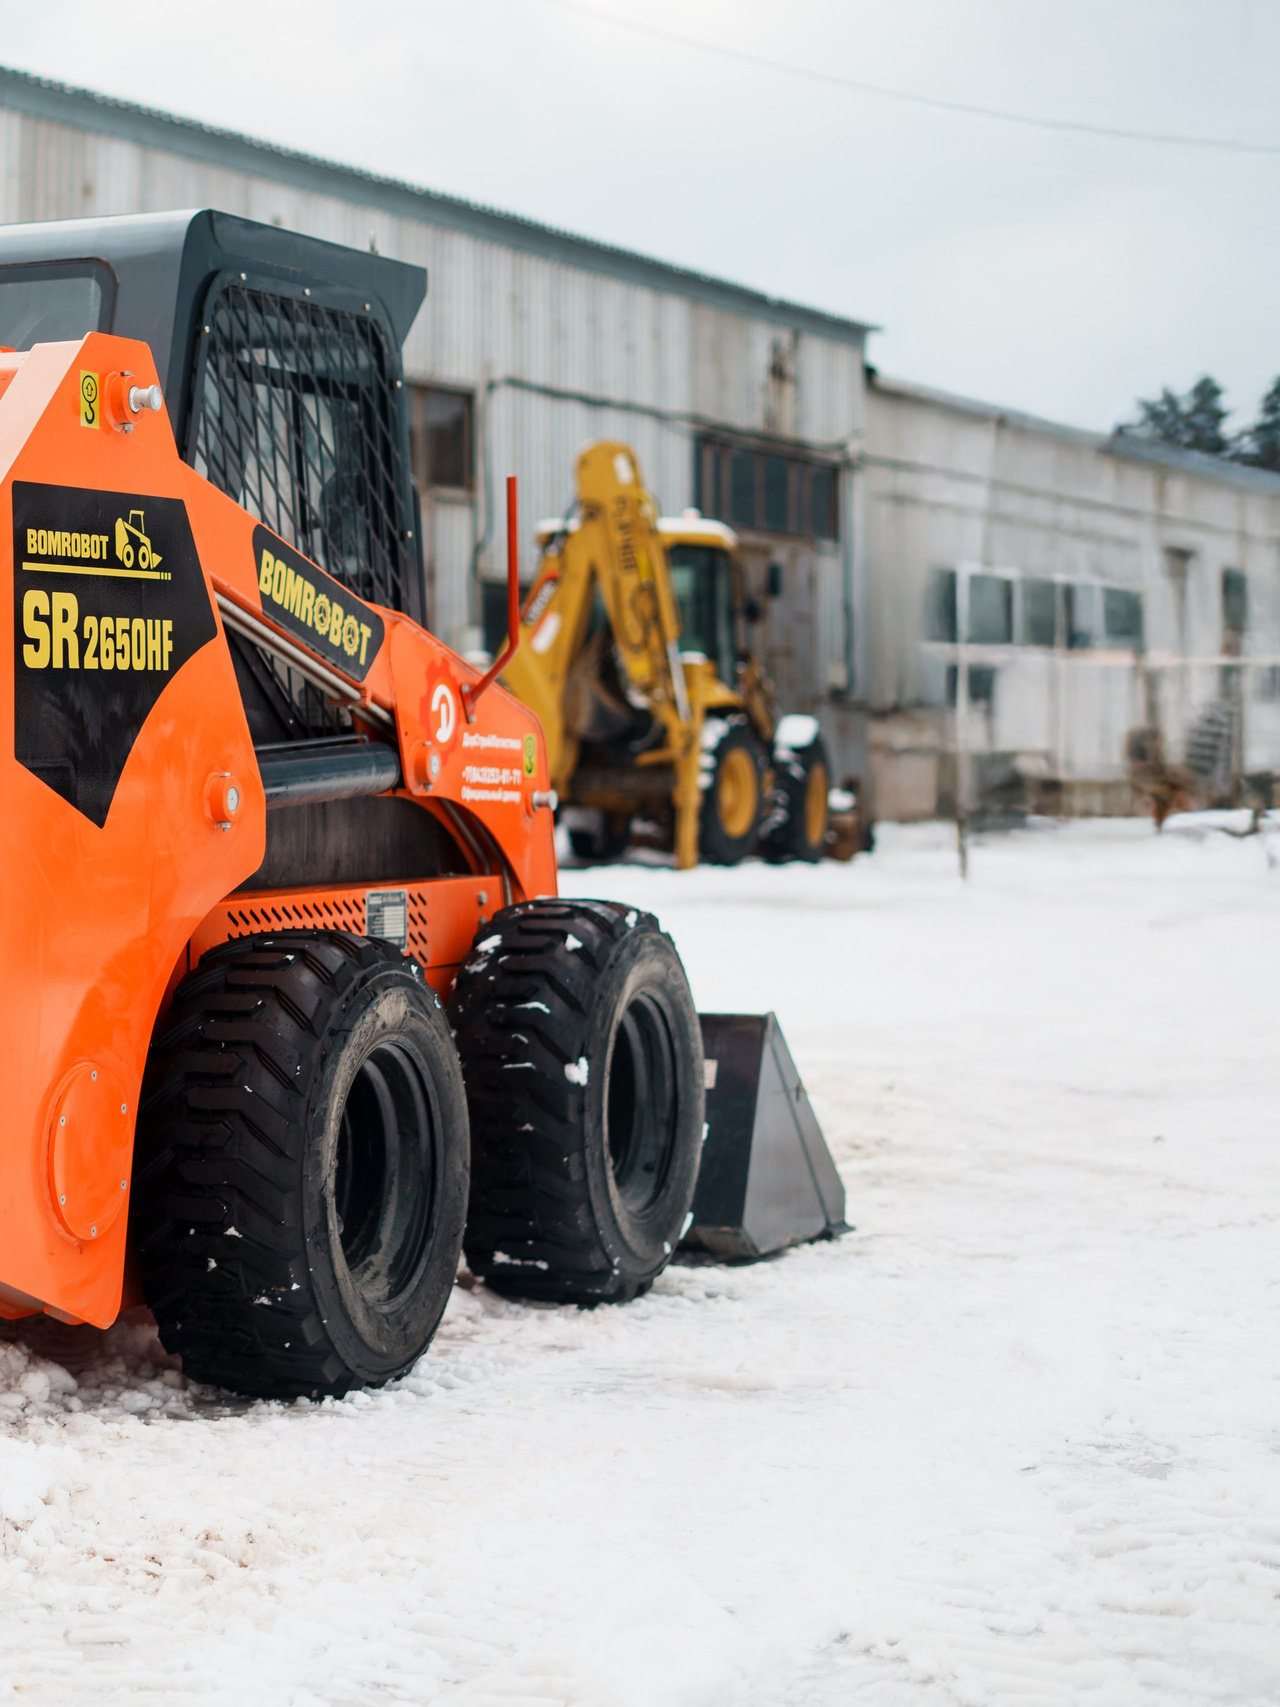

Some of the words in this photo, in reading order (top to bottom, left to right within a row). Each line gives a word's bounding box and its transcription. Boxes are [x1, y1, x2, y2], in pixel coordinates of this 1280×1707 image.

[27, 528, 109, 560] BOMROBOT
[22, 589, 80, 670] SR
[83, 615, 173, 671] 2650HF
[259, 548, 372, 666] BOMROBOT
